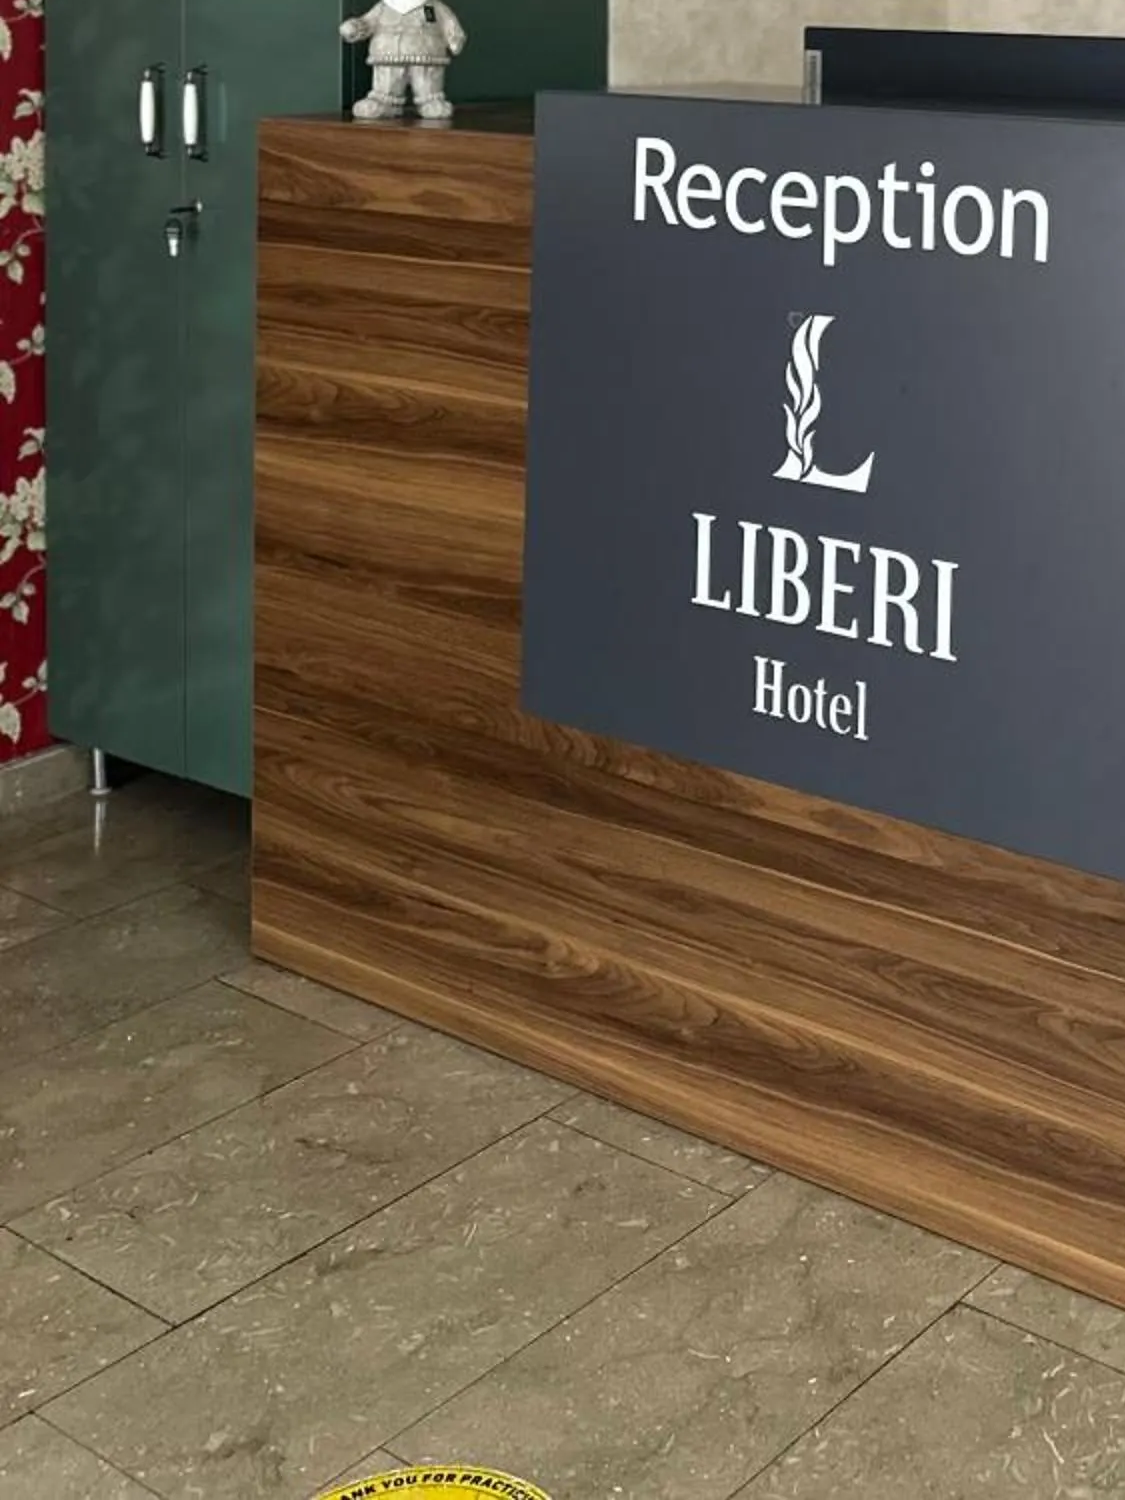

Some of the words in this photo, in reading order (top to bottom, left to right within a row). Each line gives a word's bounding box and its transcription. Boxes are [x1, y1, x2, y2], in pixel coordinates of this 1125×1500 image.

[633, 136, 1050, 268] Reception
[690, 511, 960, 663] LIBERI
[752, 654, 869, 742] Hotel
[381, 1475, 417, 1489] YOU
[422, 1473, 457, 1483] FOR
